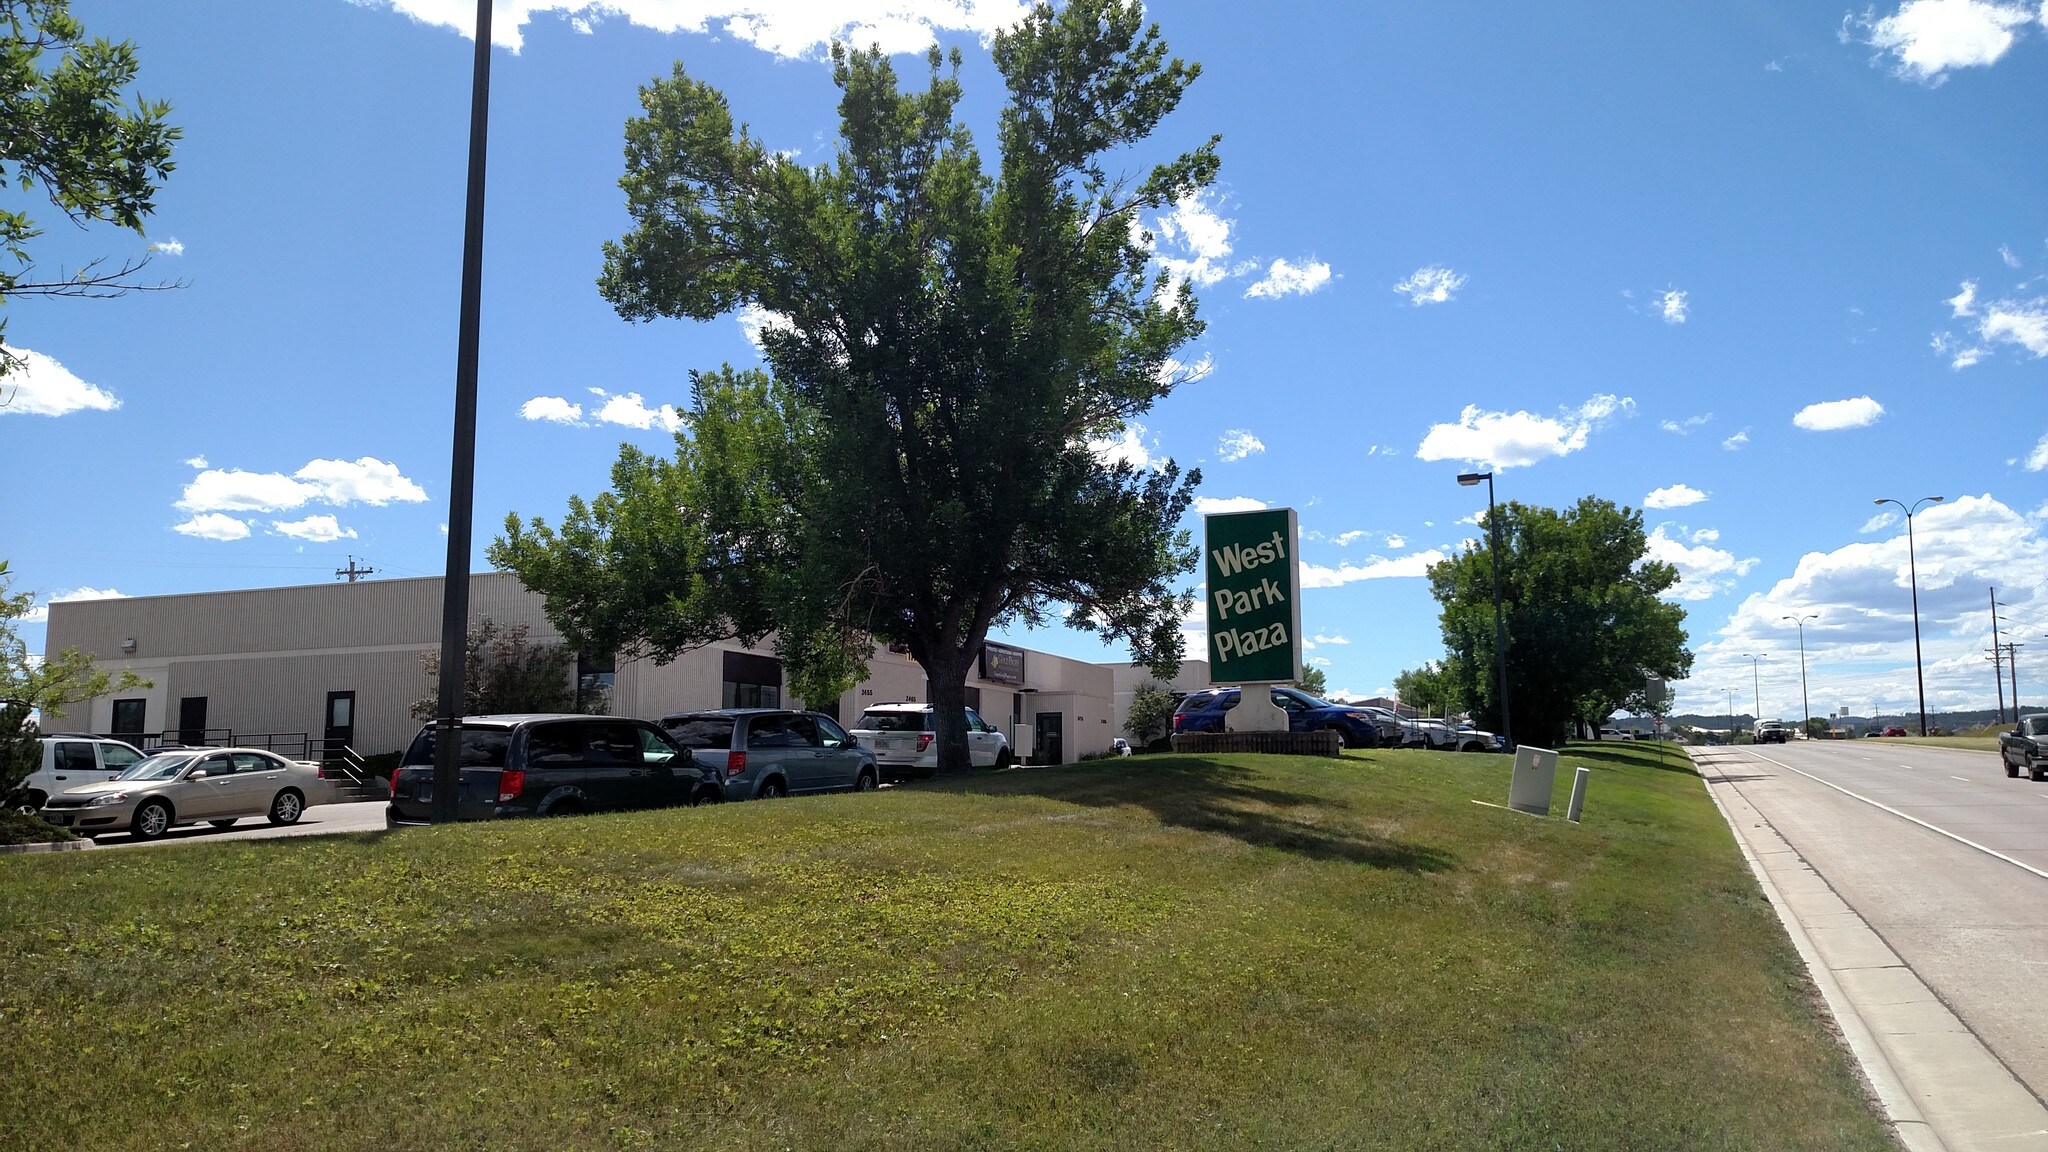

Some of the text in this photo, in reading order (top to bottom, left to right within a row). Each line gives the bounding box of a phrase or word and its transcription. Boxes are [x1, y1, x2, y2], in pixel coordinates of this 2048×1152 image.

[1212, 531, 1285, 577] West
[1214, 578, 1285, 620] Park
[1214, 622, 1288, 663] Plaza
